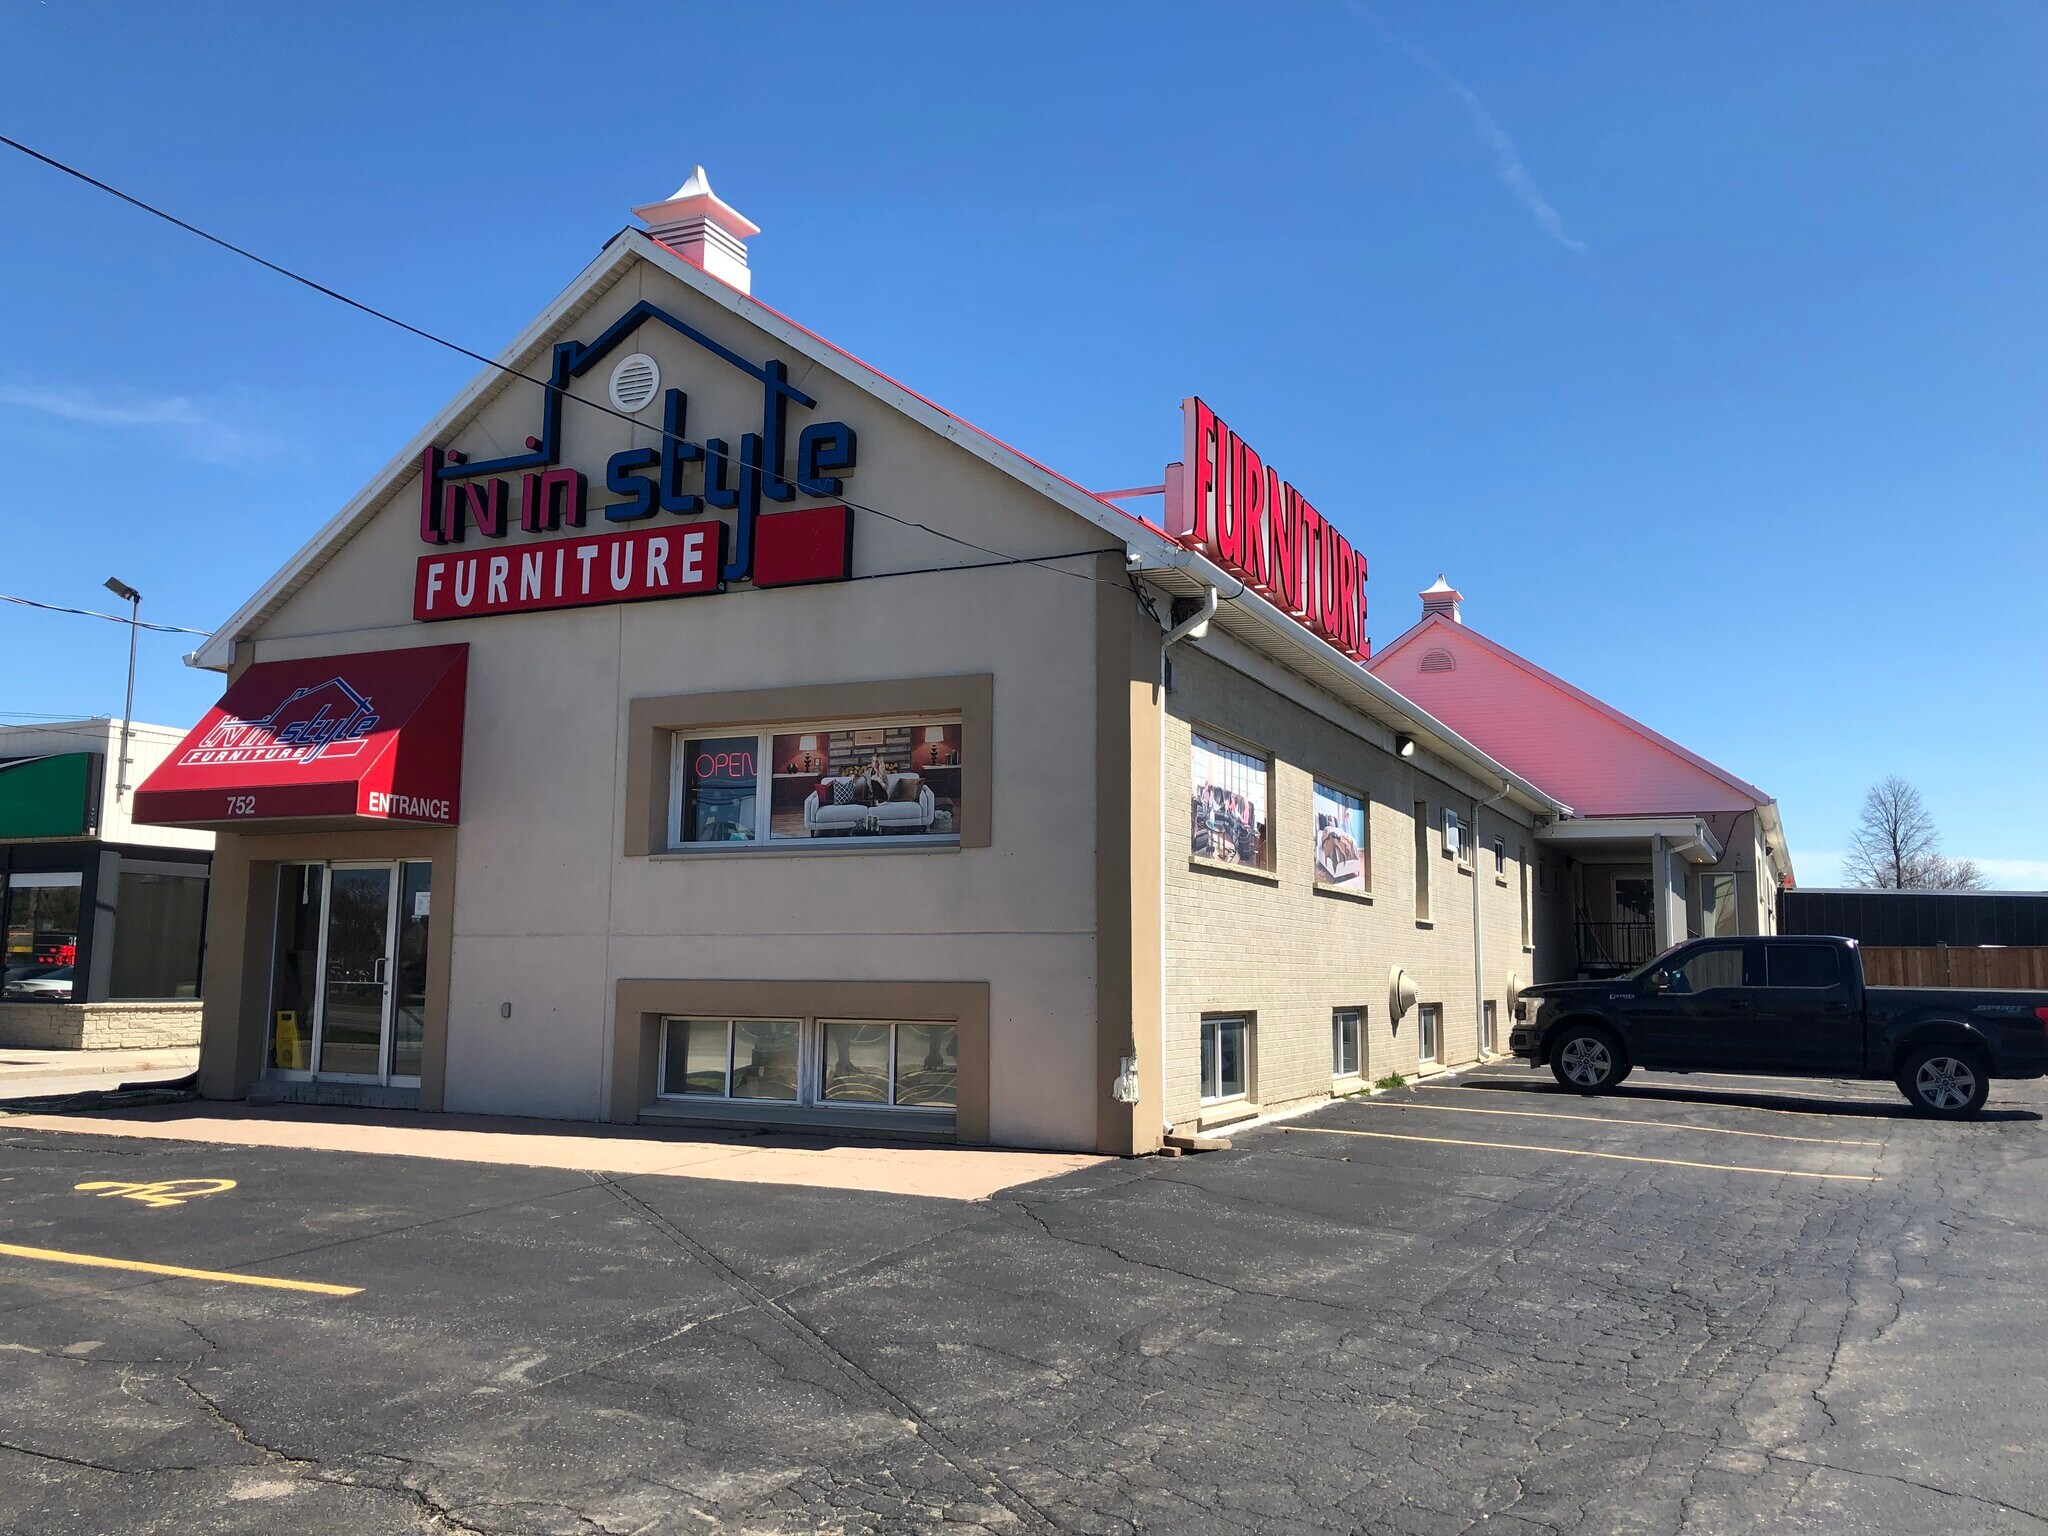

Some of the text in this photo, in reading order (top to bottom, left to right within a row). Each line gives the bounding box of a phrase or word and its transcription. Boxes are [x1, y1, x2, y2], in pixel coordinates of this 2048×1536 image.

[1193, 396, 1371, 661] FURNITURE
[425, 531, 705, 611] FURNITURE
[187, 746, 307, 763] FURNITURE
[695, 752, 757, 778] OPEN
[226, 795, 257, 816] 752
[368, 791, 450, 820] ENTRANCE
